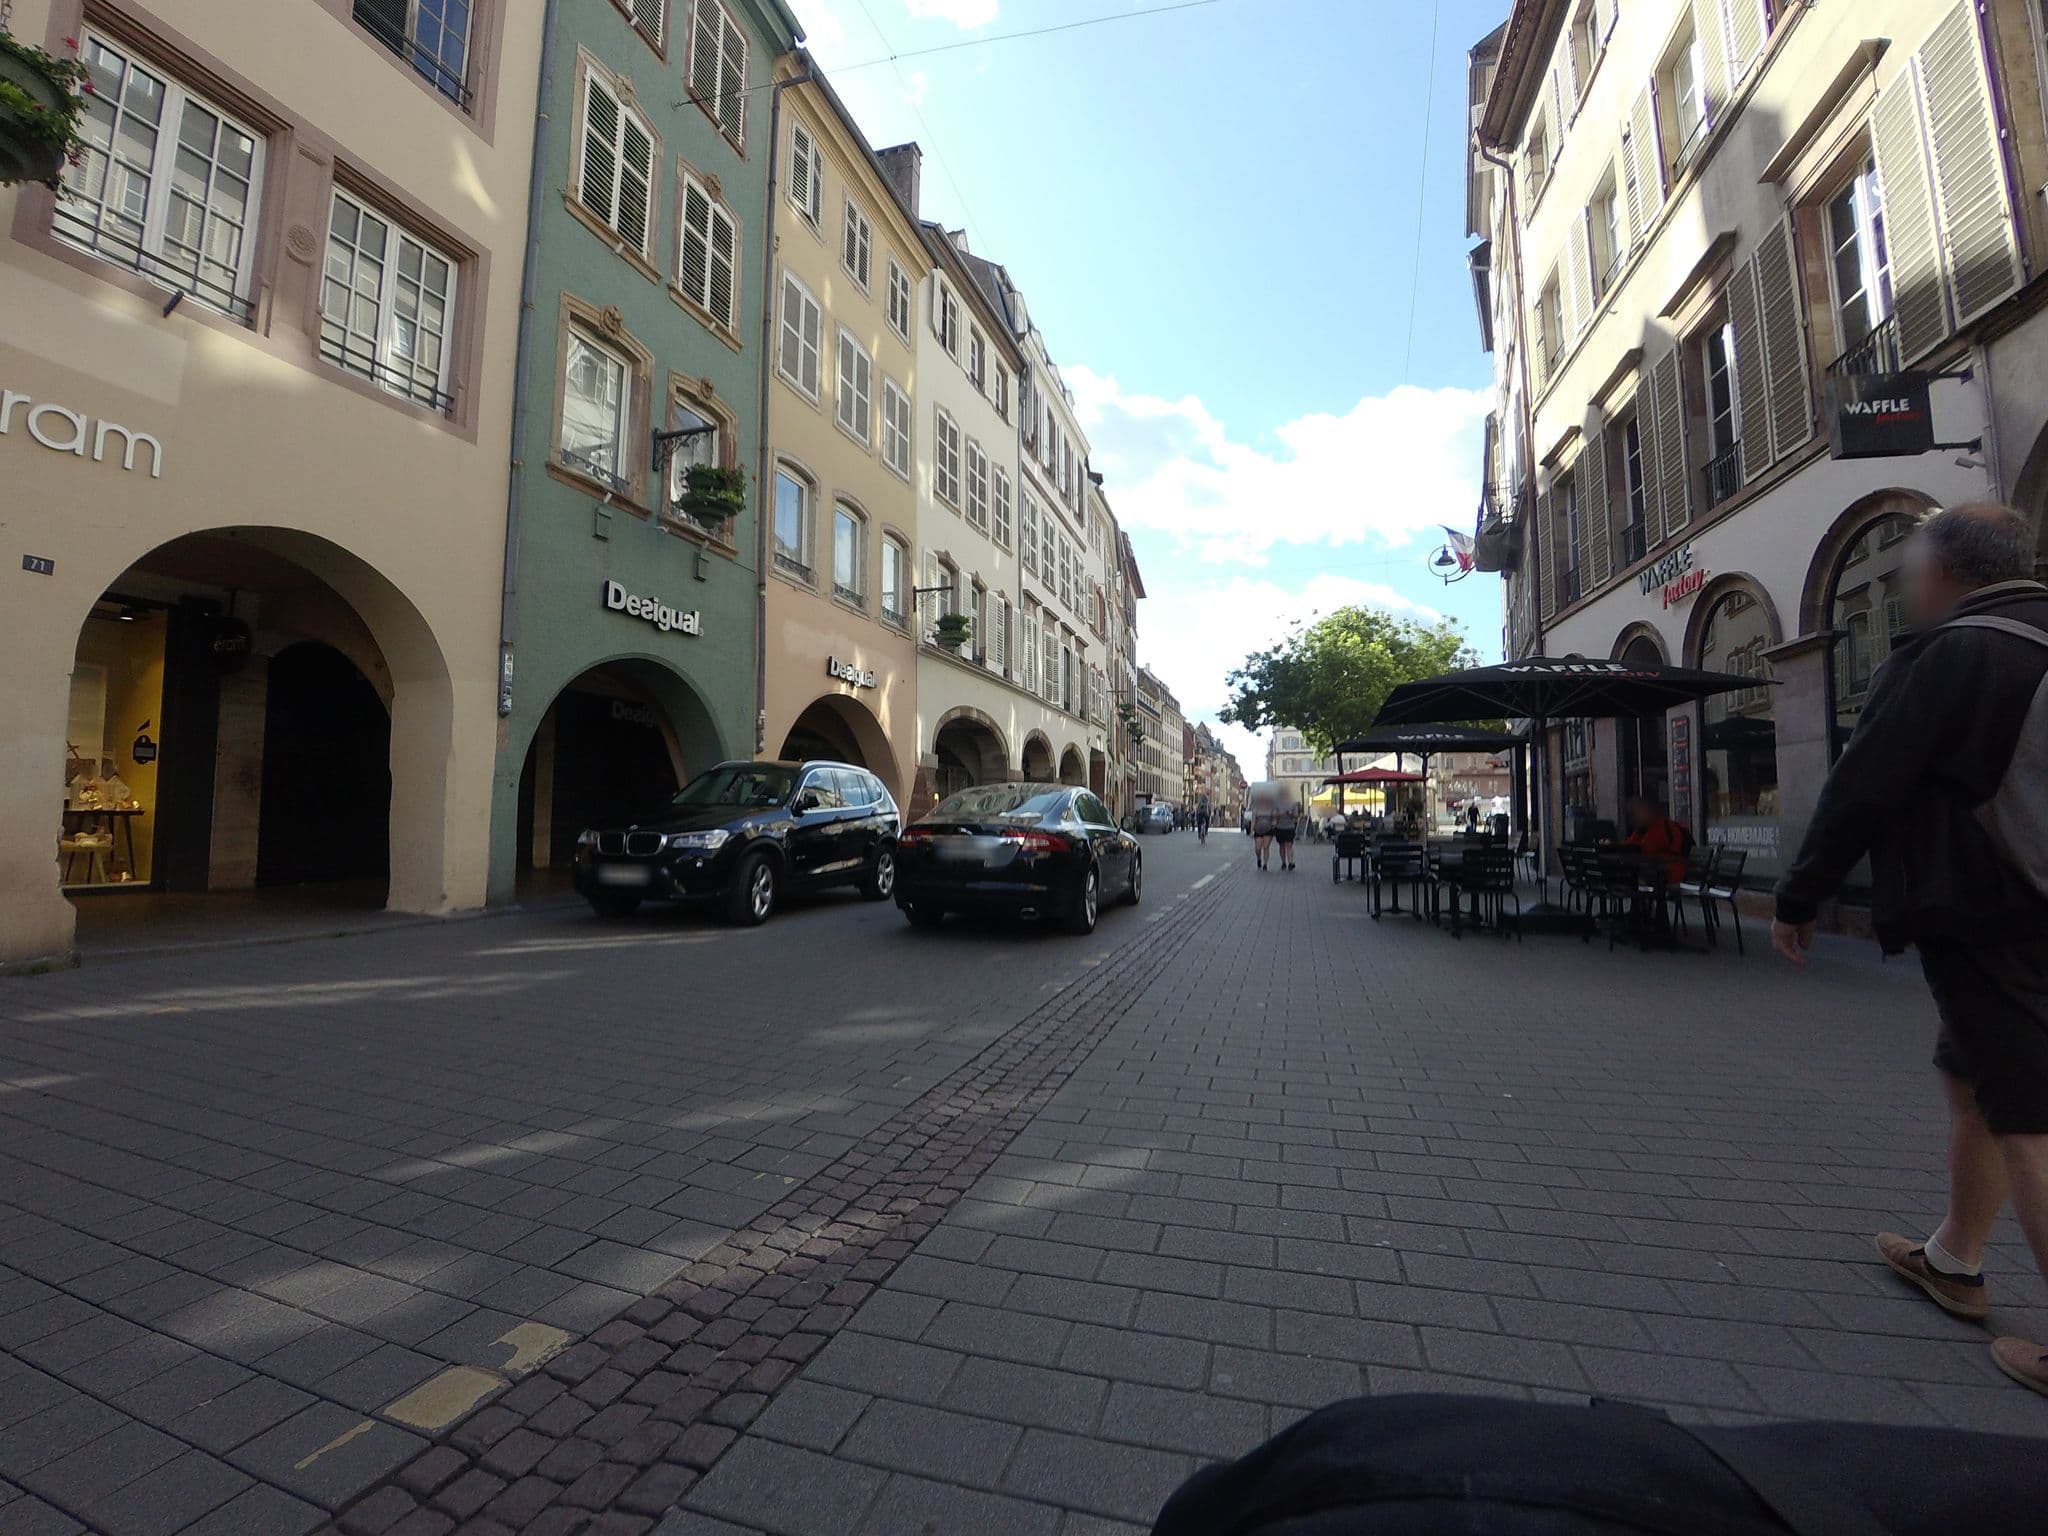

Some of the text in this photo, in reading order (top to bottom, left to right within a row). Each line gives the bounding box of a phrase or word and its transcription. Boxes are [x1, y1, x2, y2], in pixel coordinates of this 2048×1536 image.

[1844, 397, 1911, 416] WAFFLE
[31, 558, 46, 571] 71
[1637, 543, 1693, 596] WAFFLE
[606, 580, 702, 636] Desigual
[828, 656, 876, 688] Desigual
[1497, 663, 1629, 673] WAFFLE
